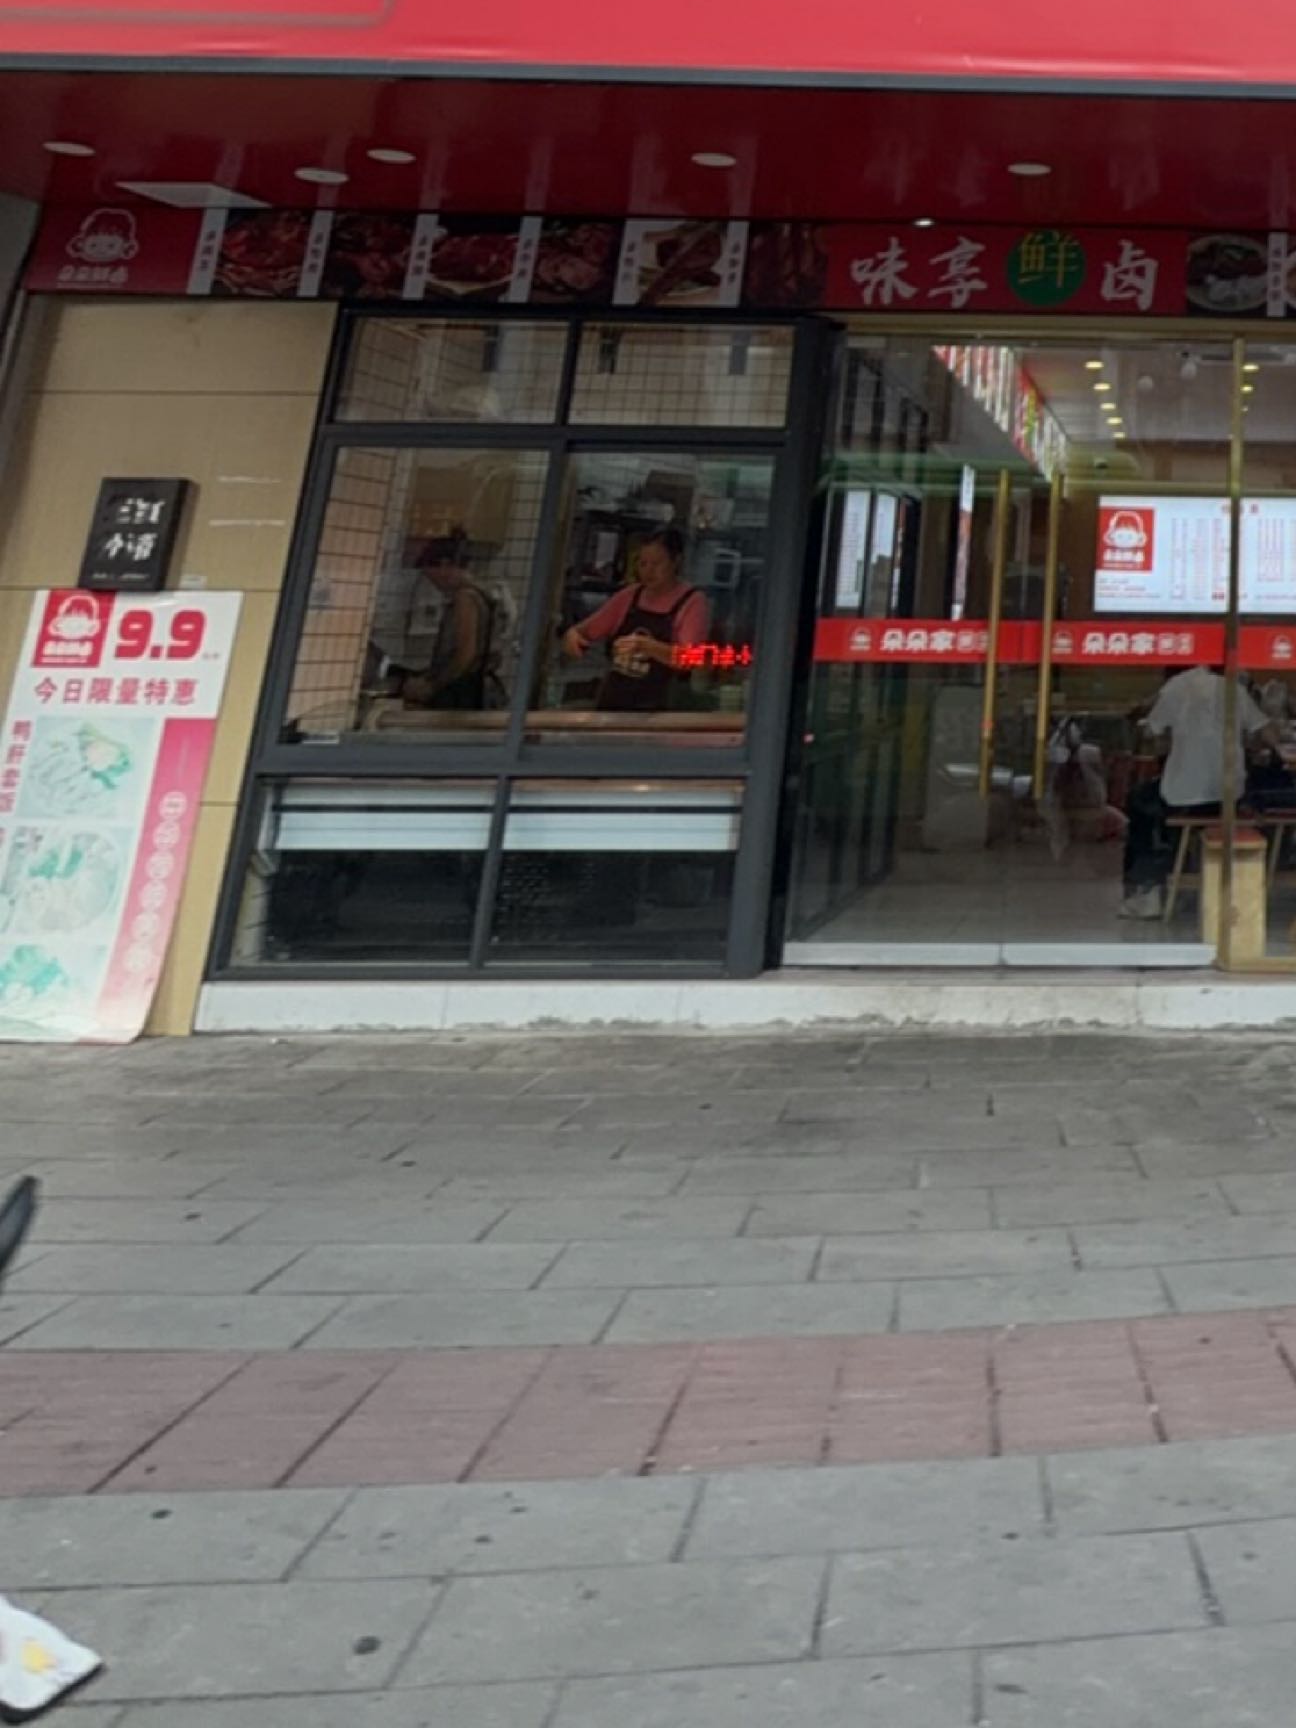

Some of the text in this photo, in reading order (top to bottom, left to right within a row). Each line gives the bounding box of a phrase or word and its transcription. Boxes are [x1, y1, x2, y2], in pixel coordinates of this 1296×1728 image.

[850, 230, 1159, 312] 味享鲜卤
[114, 608, 208, 661] 9.9
[34, 676, 200, 706] 今日限量特惠
